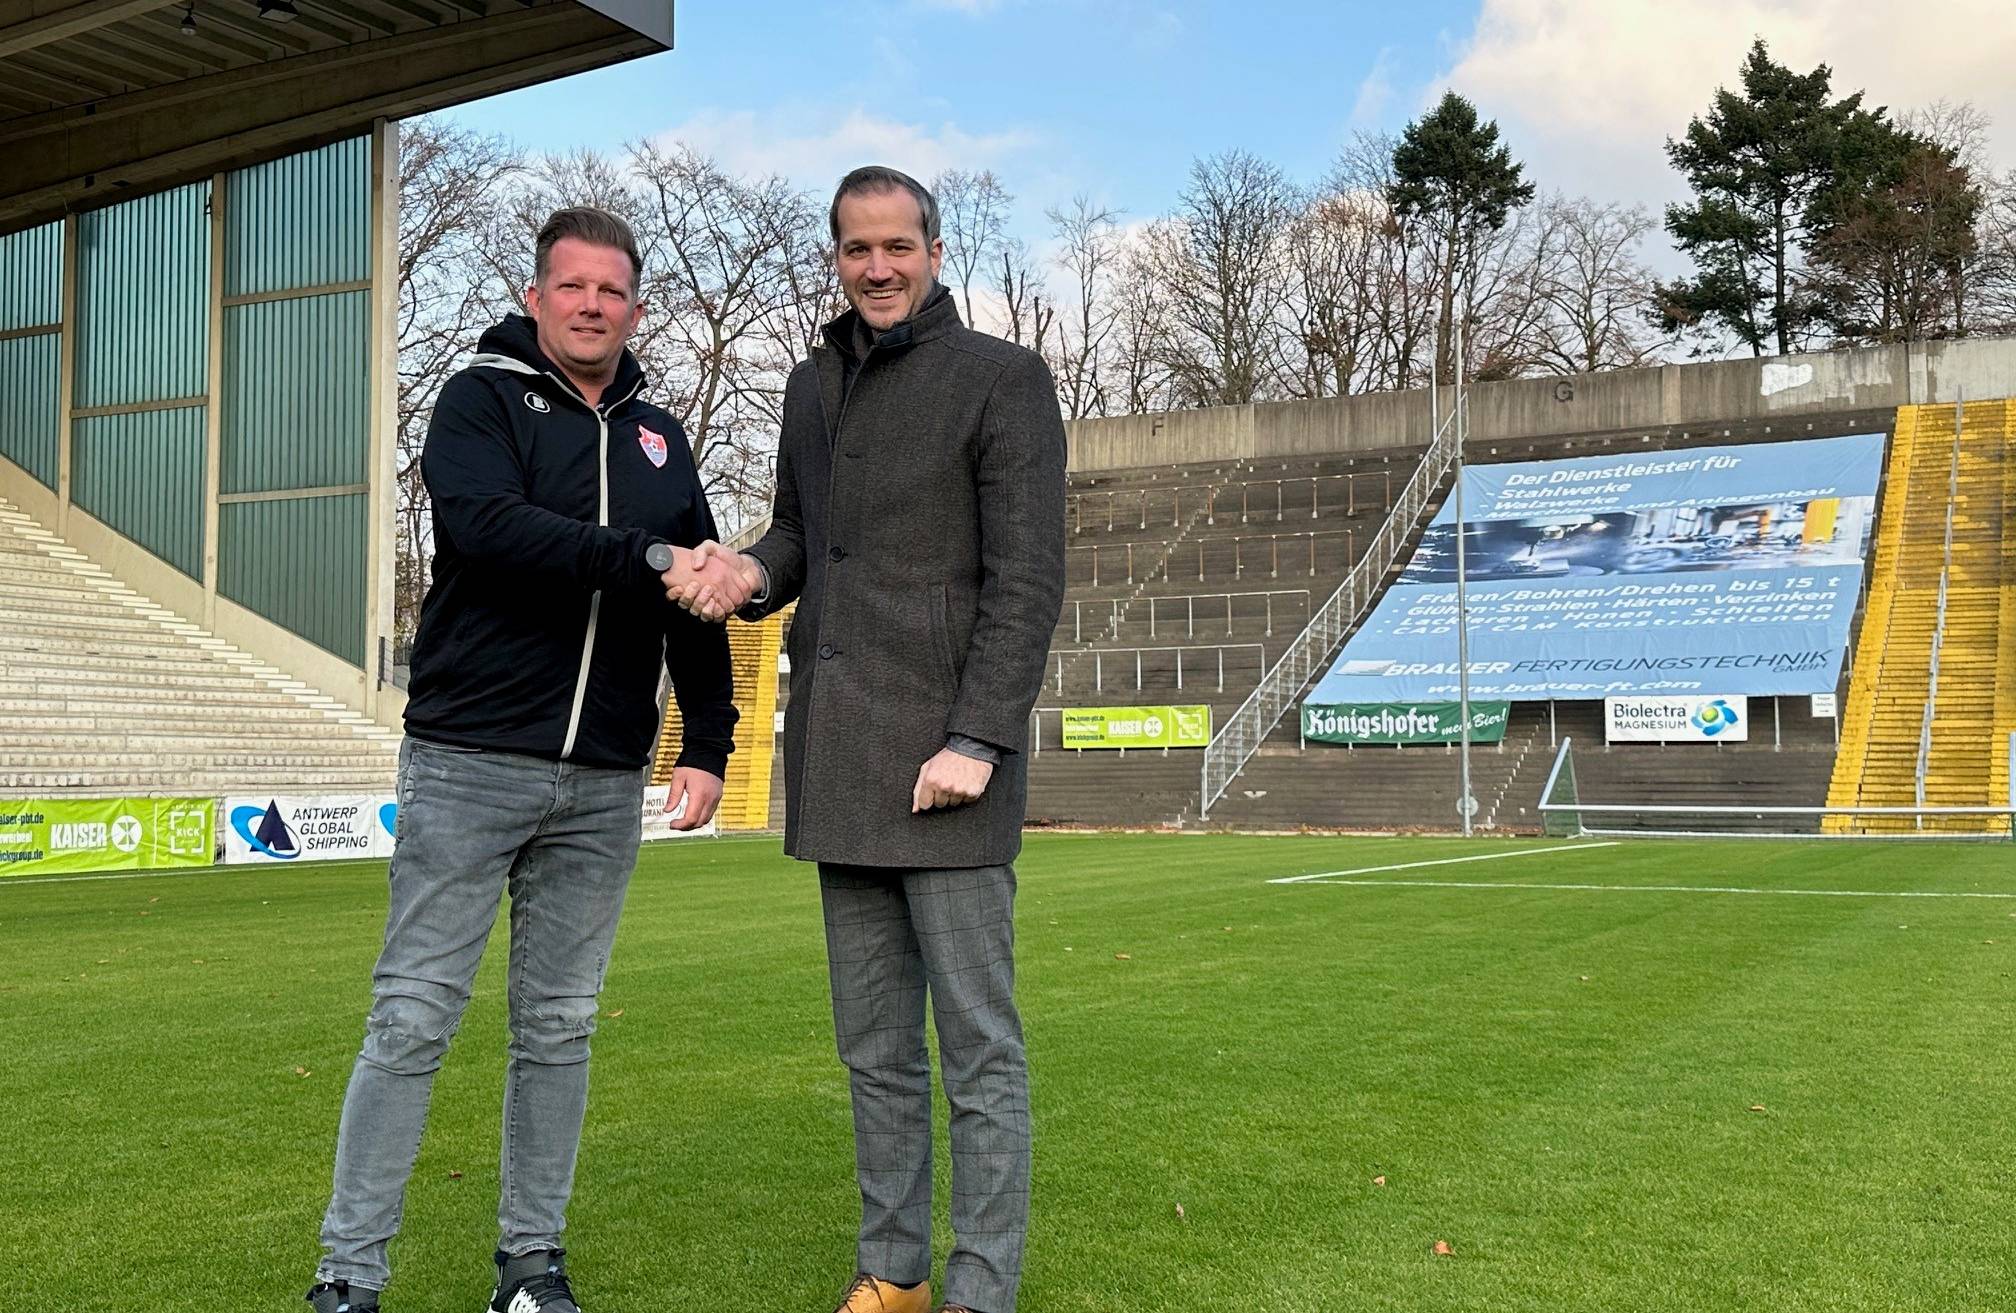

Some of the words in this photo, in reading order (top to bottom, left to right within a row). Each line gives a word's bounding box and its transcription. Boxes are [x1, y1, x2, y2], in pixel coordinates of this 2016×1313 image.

[1554, 381, 1573, 402] G
[1505, 474, 1547, 486] Der
[1549, 459, 1701, 484] Dienstleister
[1702, 455, 1742, 472] für
[1498, 482, 1632, 499] Stahlwerke
[1494, 496, 1620, 510] Walzwerke
[1728, 579, 1771, 592] bis
[1785, 577, 1814, 589] 15
[1827, 576, 1840, 587] t
[1400, 615, 1529, 626] Lackeren
[1562, 610, 1653, 621] Honen
[1691, 603, 1834, 617] Schleifen
[1392, 626, 1451, 635] CAD
[1491, 622, 1558, 632] CAM
[1573, 612, 1832, 629] Konstruktionen
[1512, 650, 1833, 674] FERTIGUNGSTECHNIK
[1614, 703, 1686, 718] Biolectra
[1304, 707, 1440, 738] Königshofer
[1472, 708, 1507, 729] Bier!
[1614, 720, 1687, 729] MAGNESIUM
[292, 807, 358, 820] ANTWERP
[51, 822, 107, 849] KAISER
[176, 827, 200, 837] KICK
[300, 822, 354, 835] GLOBAL
[306, 836, 368, 850] SHIPPING
